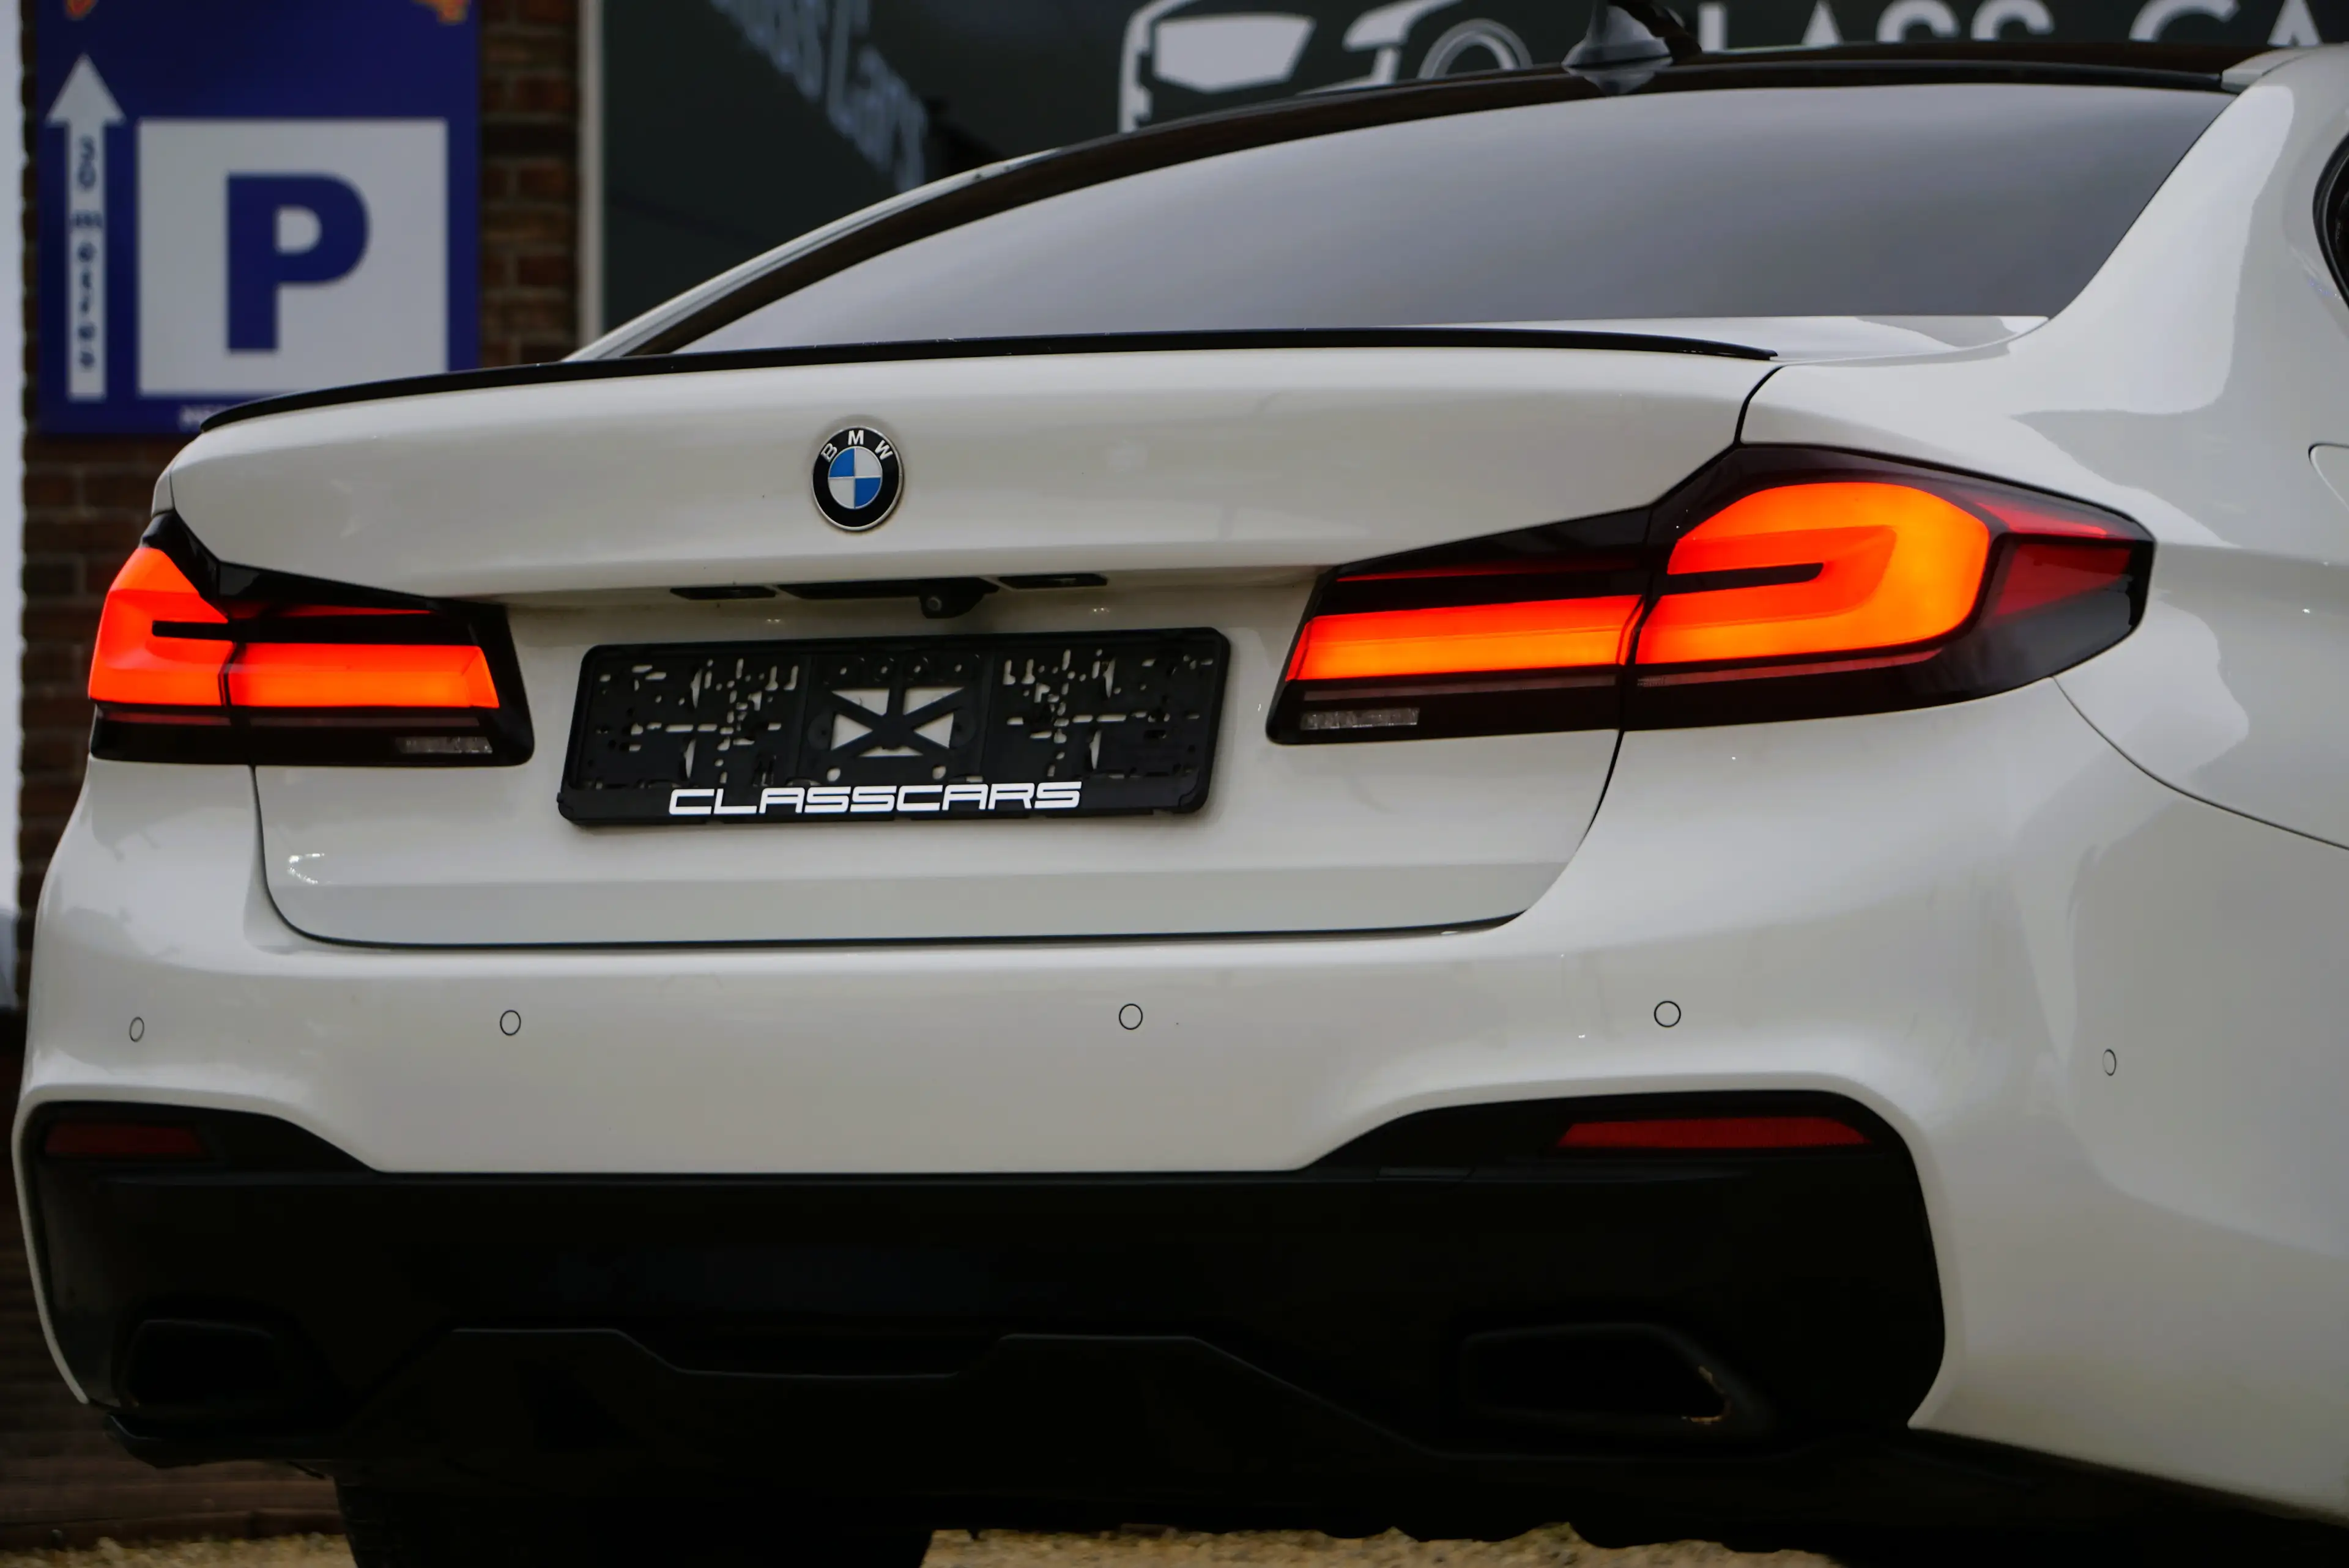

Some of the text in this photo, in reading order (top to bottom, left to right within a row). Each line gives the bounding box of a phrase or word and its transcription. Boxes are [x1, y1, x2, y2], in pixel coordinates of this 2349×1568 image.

[227, 172, 370, 355] P
[820, 430, 893, 462] BMW
[669, 781, 1083, 815] CLASSCARS
